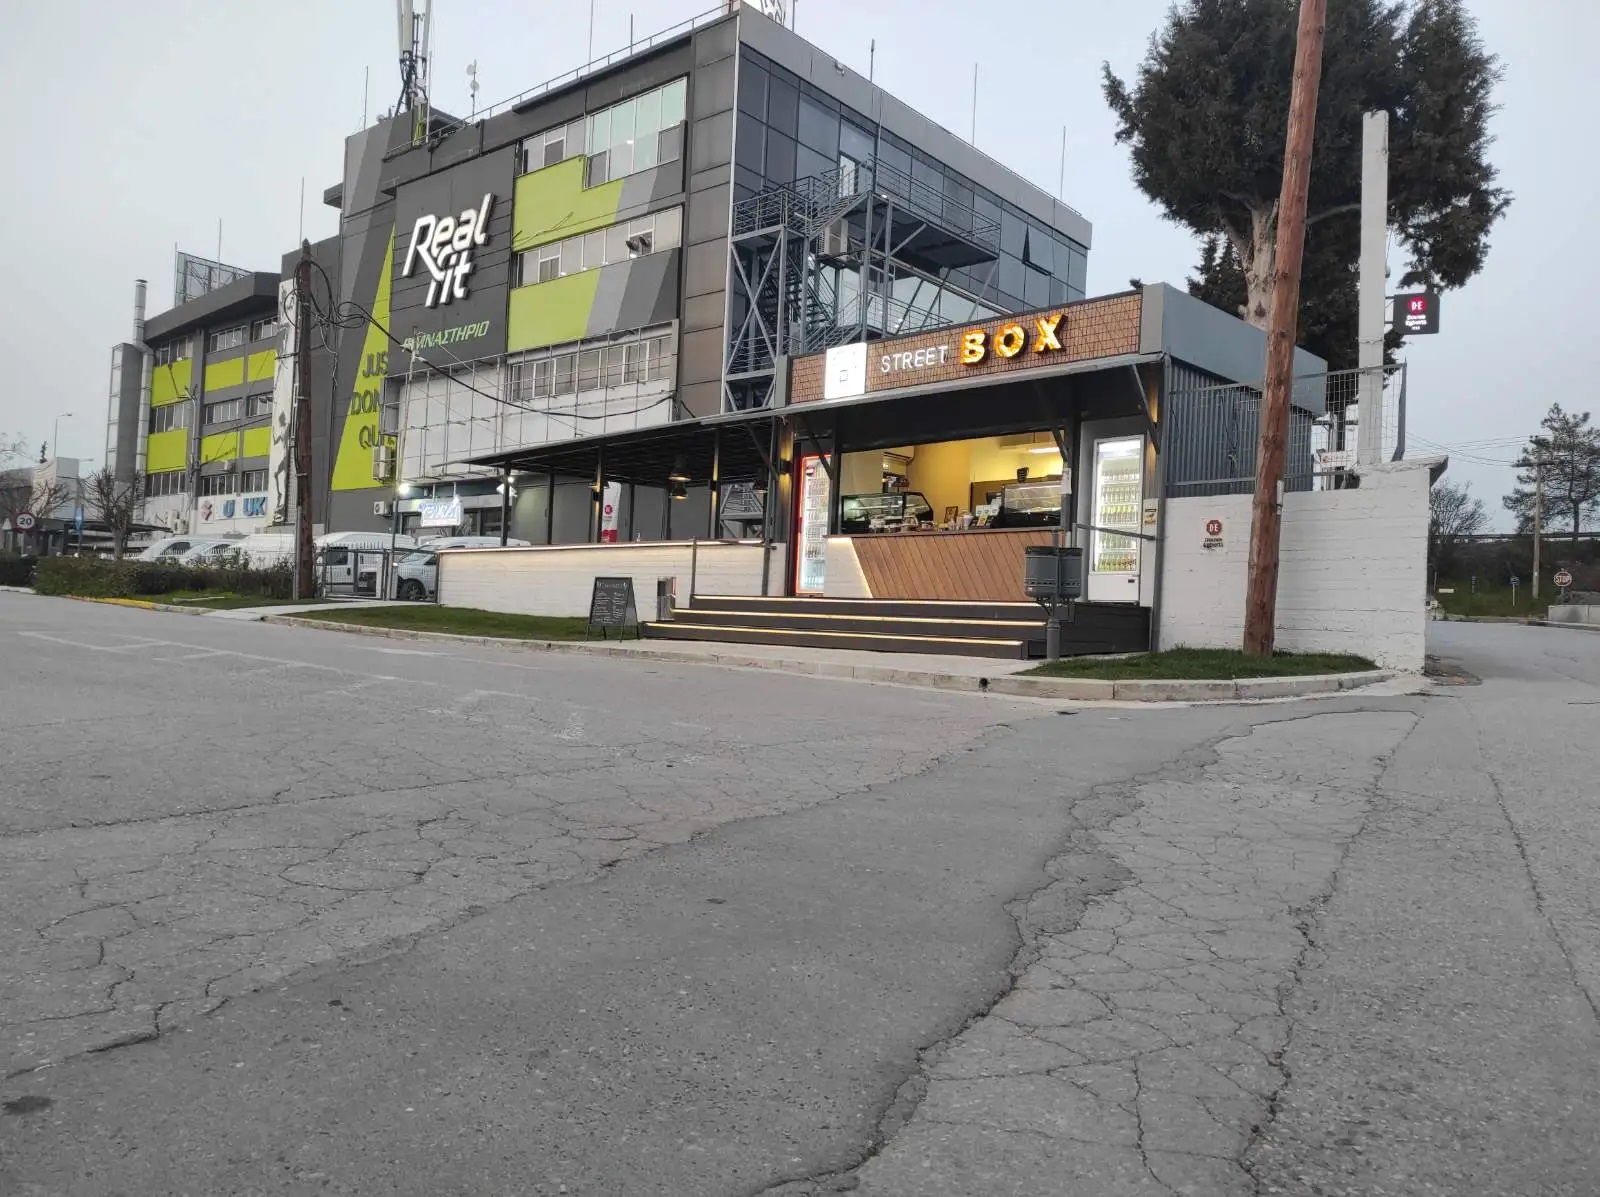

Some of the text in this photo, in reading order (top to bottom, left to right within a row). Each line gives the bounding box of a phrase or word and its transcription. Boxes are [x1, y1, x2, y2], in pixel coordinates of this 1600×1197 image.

[402, 193, 494, 281] Real
[404, 320, 490, 350] ΜΝΑΣΤΗΡΙΟ
[880, 344, 949, 373] STREET
[959, 313, 1067, 366] BOX
[19, 517, 32, 525] 20
[1555, 575, 1571, 583] STOP
